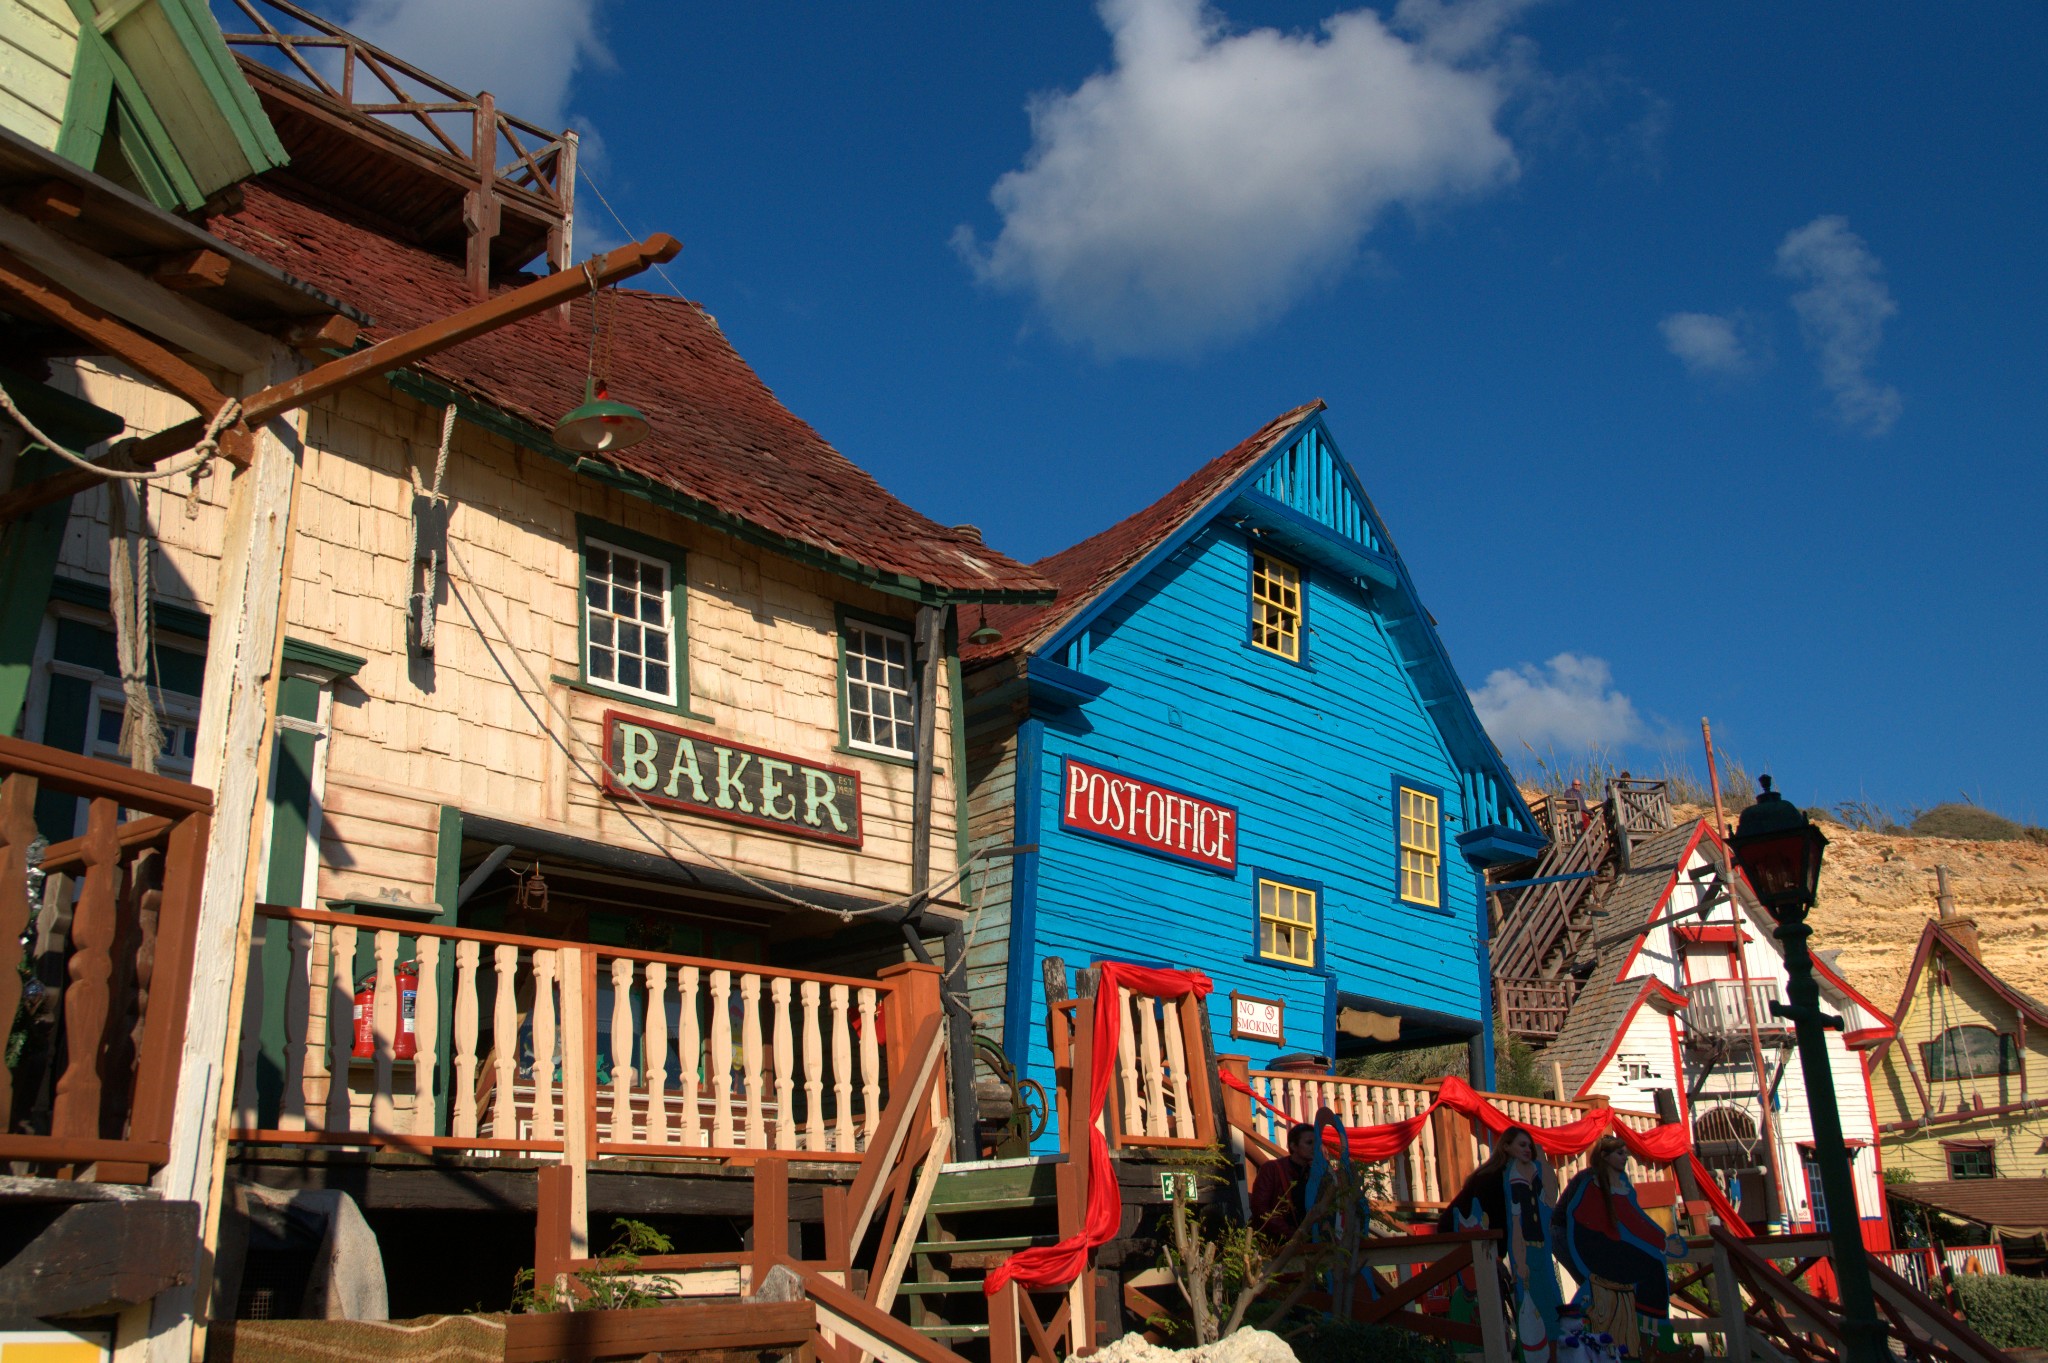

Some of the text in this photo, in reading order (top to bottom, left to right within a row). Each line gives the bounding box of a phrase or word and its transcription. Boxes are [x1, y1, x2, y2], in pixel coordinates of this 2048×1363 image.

[617, 722, 849, 833] BAKER
[1067, 764, 1233, 863] POST-OFFICE
[1237, 1016, 1278, 1035] SMOKING
[1240, 1001, 1255, 1016] NO
